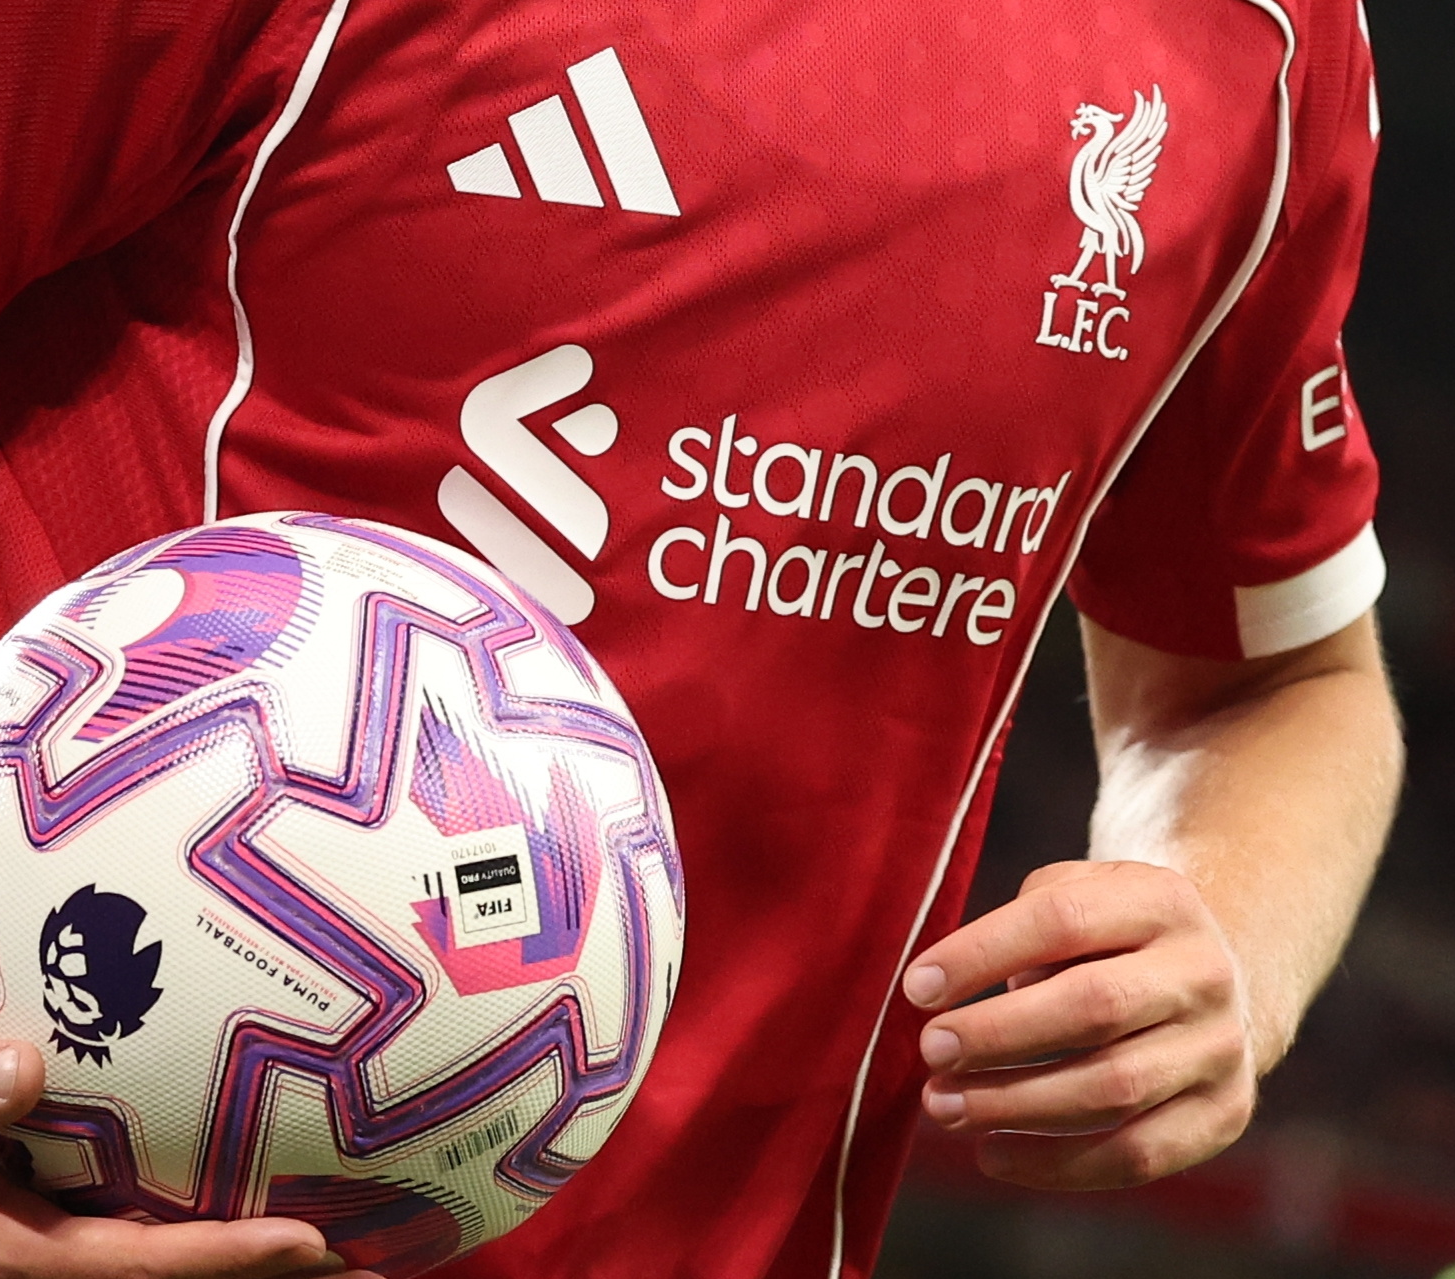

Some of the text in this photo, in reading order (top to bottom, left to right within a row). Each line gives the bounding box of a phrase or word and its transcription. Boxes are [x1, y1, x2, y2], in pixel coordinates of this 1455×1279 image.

[1035, 291, 1130, 361] L.F.C.
[1301, 364, 1347, 452] E
[660, 413, 1073, 555] standard
[648, 513, 1017, 646] chartere
[451, 842, 497, 860] 1017170
[460, 865, 516, 884] QUALITY PRO
[195, 914, 330, 1012] PUMA FOOTBALL
